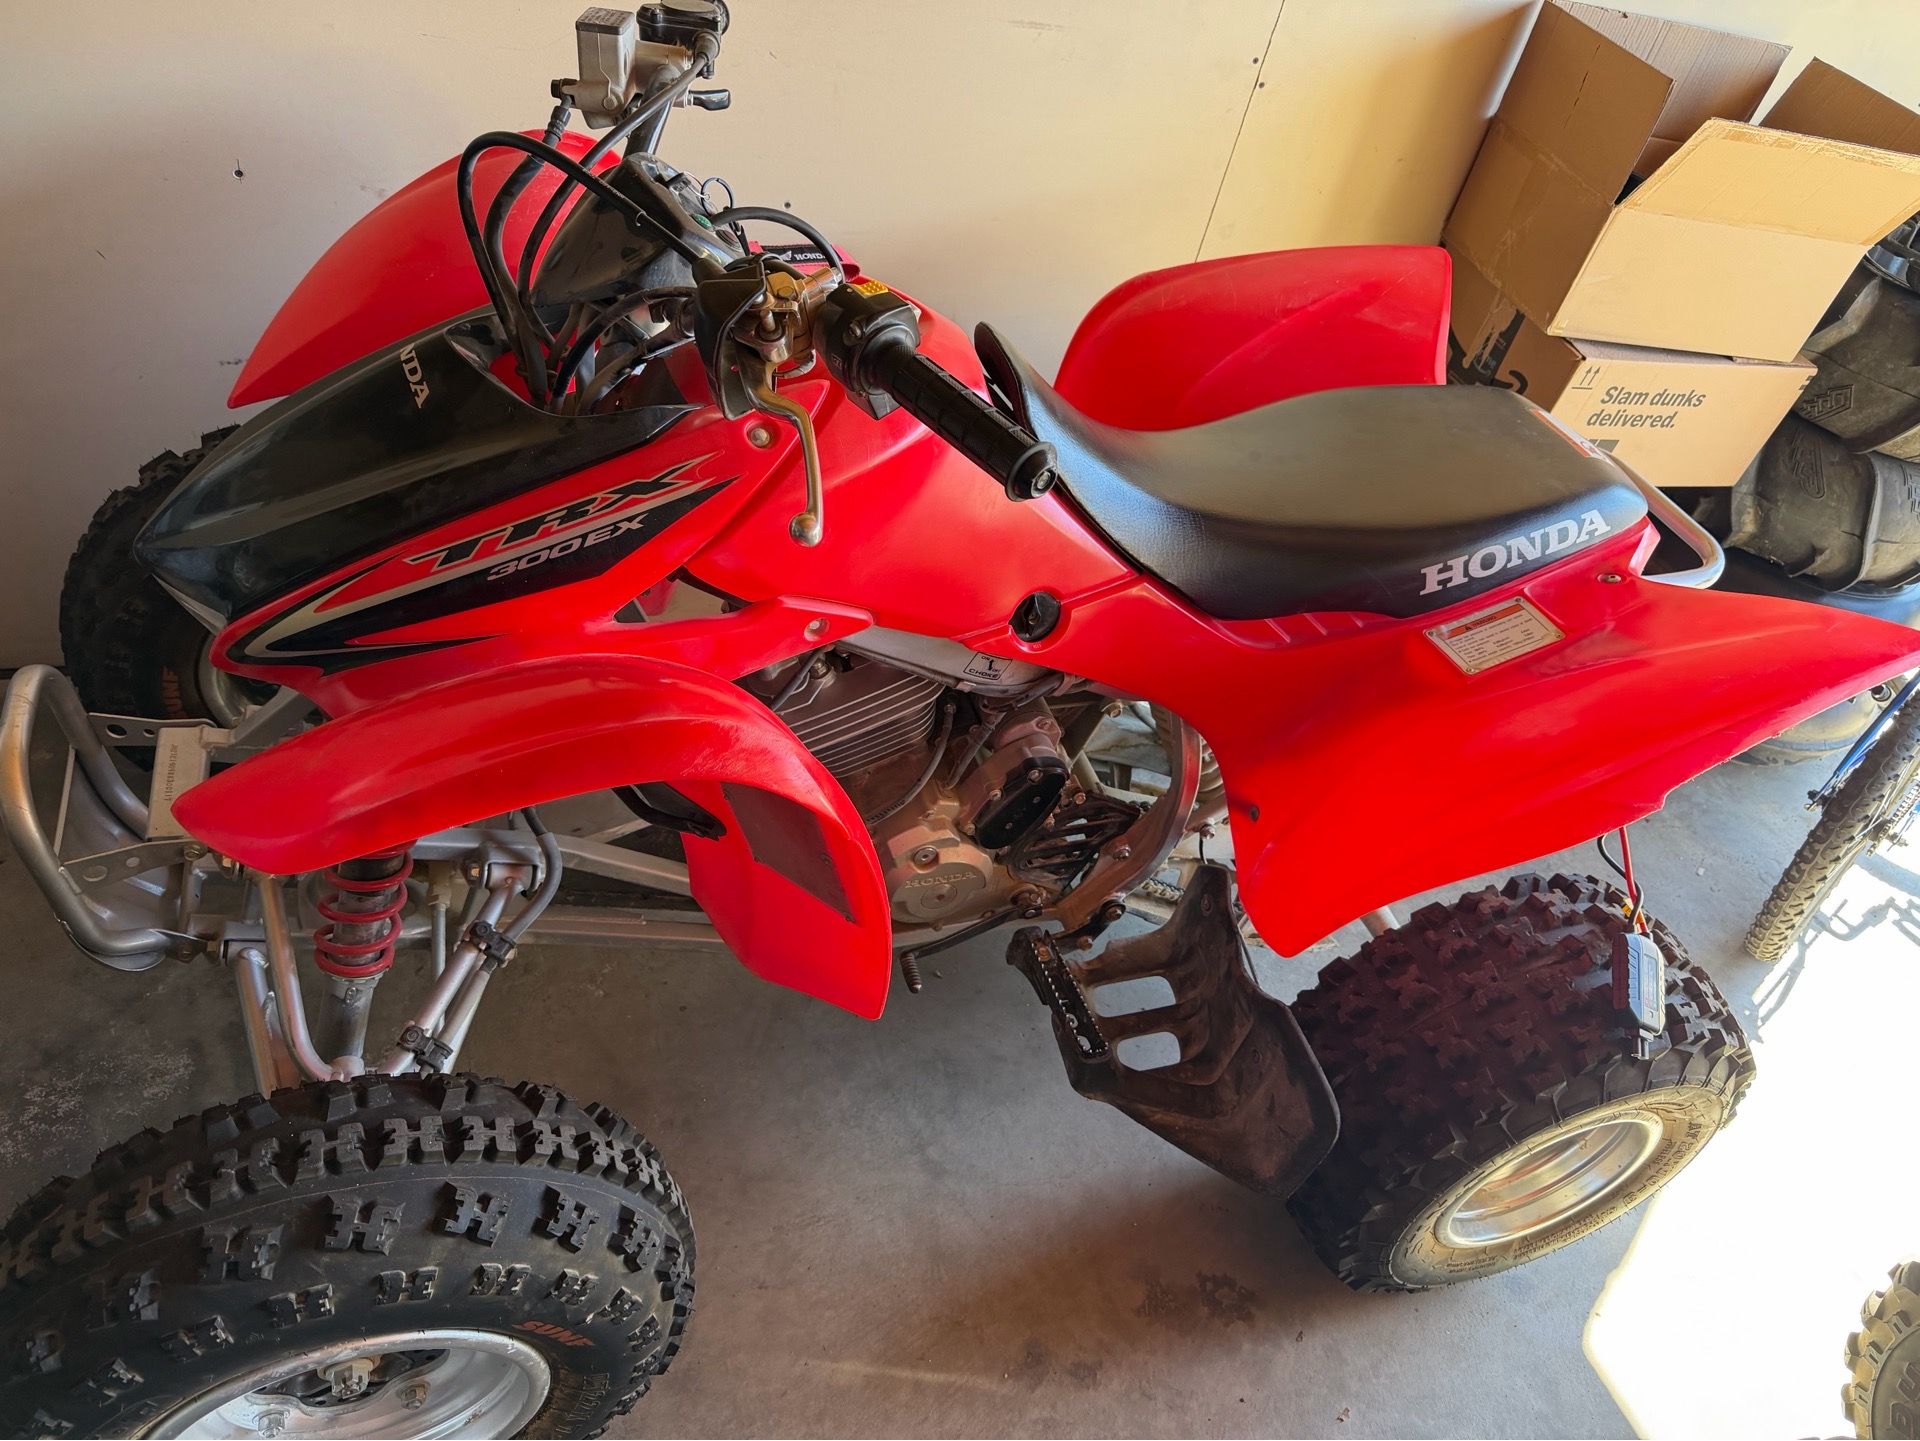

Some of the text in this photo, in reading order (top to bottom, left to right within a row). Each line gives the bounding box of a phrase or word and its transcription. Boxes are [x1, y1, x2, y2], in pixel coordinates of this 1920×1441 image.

[793, 252, 826, 261] HOND
[400, 343, 430, 408] NDA
[1600, 386, 1707, 408] Slam dunks
[1586, 409, 1679, 429] delivered.
[402, 451, 722, 572] TRX
[486, 513, 648, 581] 300EX
[1419, 509, 1612, 596] HONDA
[969, 667, 998, 678] CHOKE
[904, 871, 977, 889] HONDA
